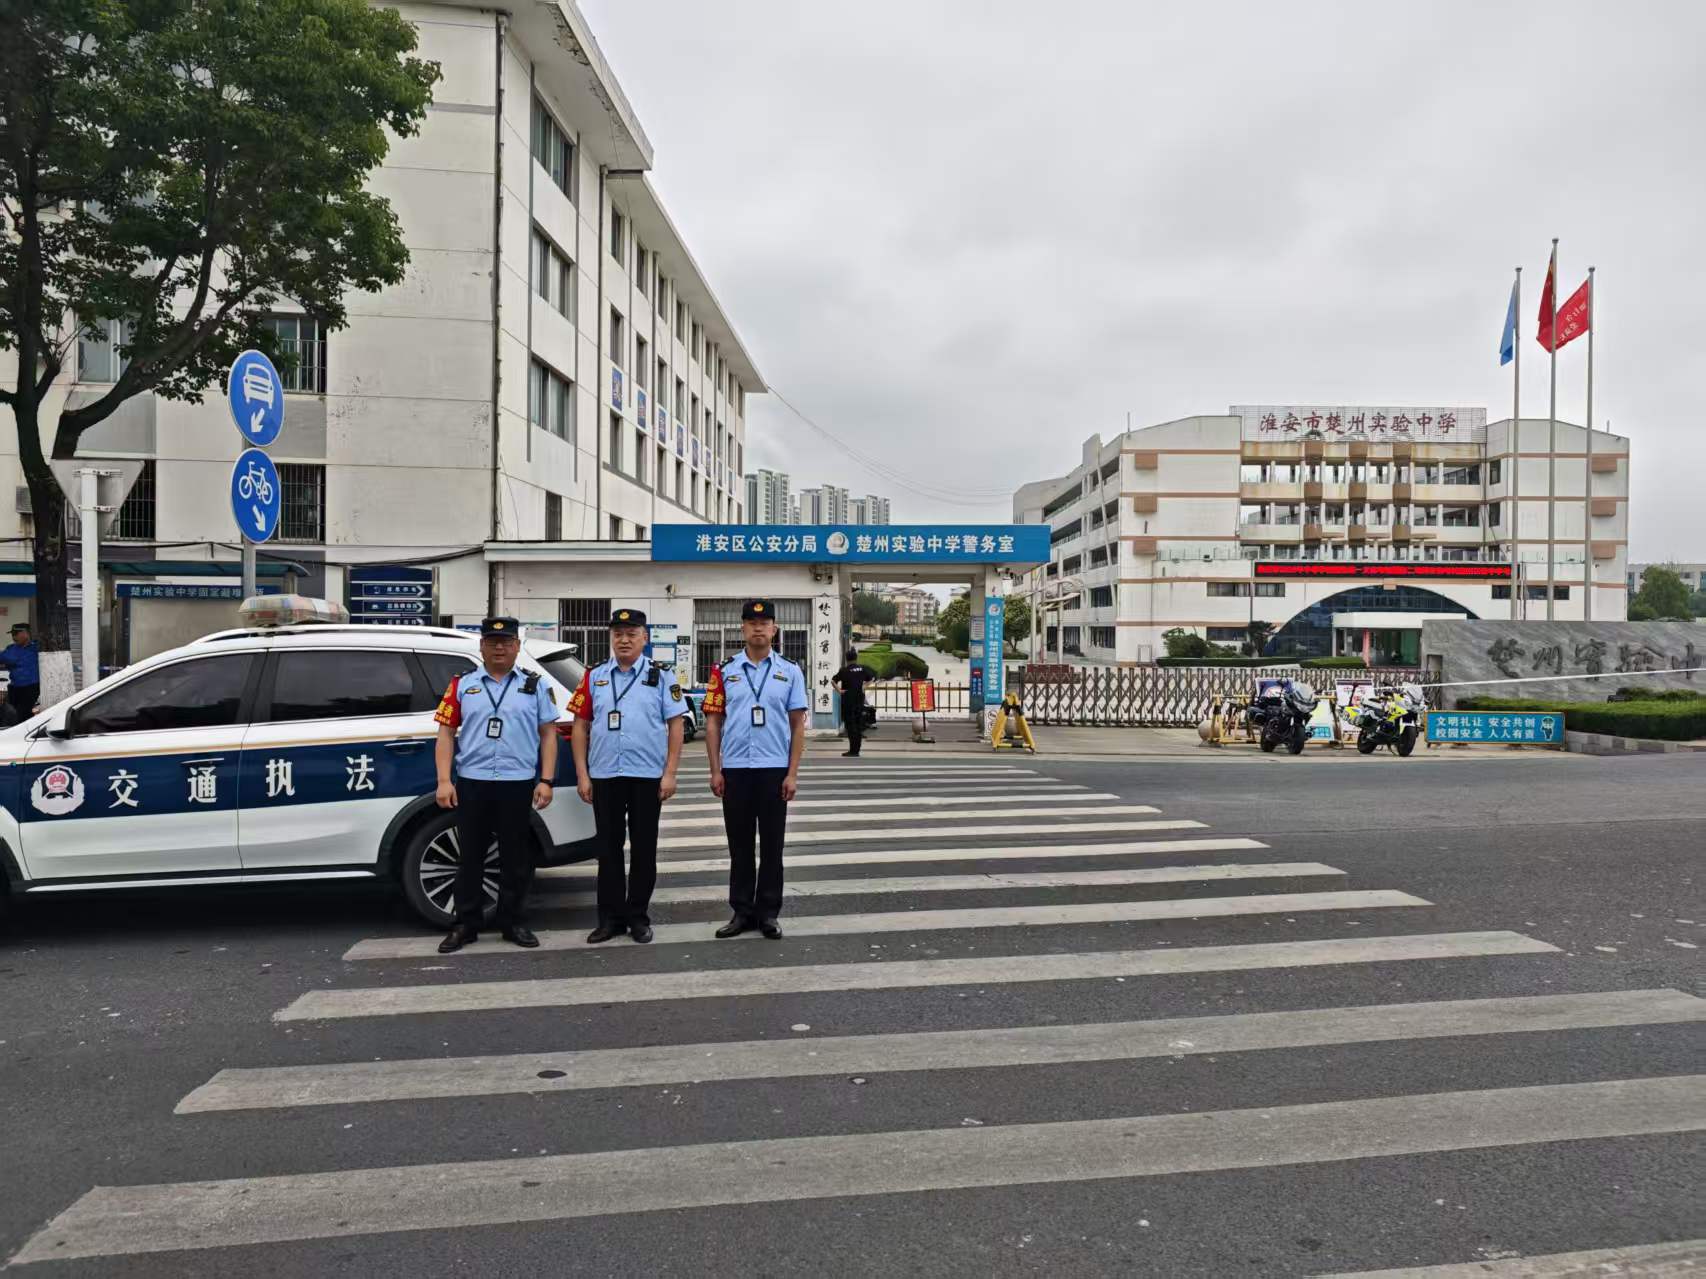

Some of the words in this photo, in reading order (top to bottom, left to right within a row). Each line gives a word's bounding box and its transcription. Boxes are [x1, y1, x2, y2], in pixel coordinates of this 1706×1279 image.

[1259, 409, 1457, 435] 淮安市楚州实验中学
[696, 533, 817, 554] 淮安区公安分局
[856, 534, 1015, 554] 楚州实验中学警务室
[1436, 716, 1483, 727] 文明礼让
[1488, 717, 1536, 728] 安全共创
[1436, 728, 1483, 738] 校园安全
[1488, 729, 1535, 739] 人人有责
[108, 754, 375, 809] 交通执法
